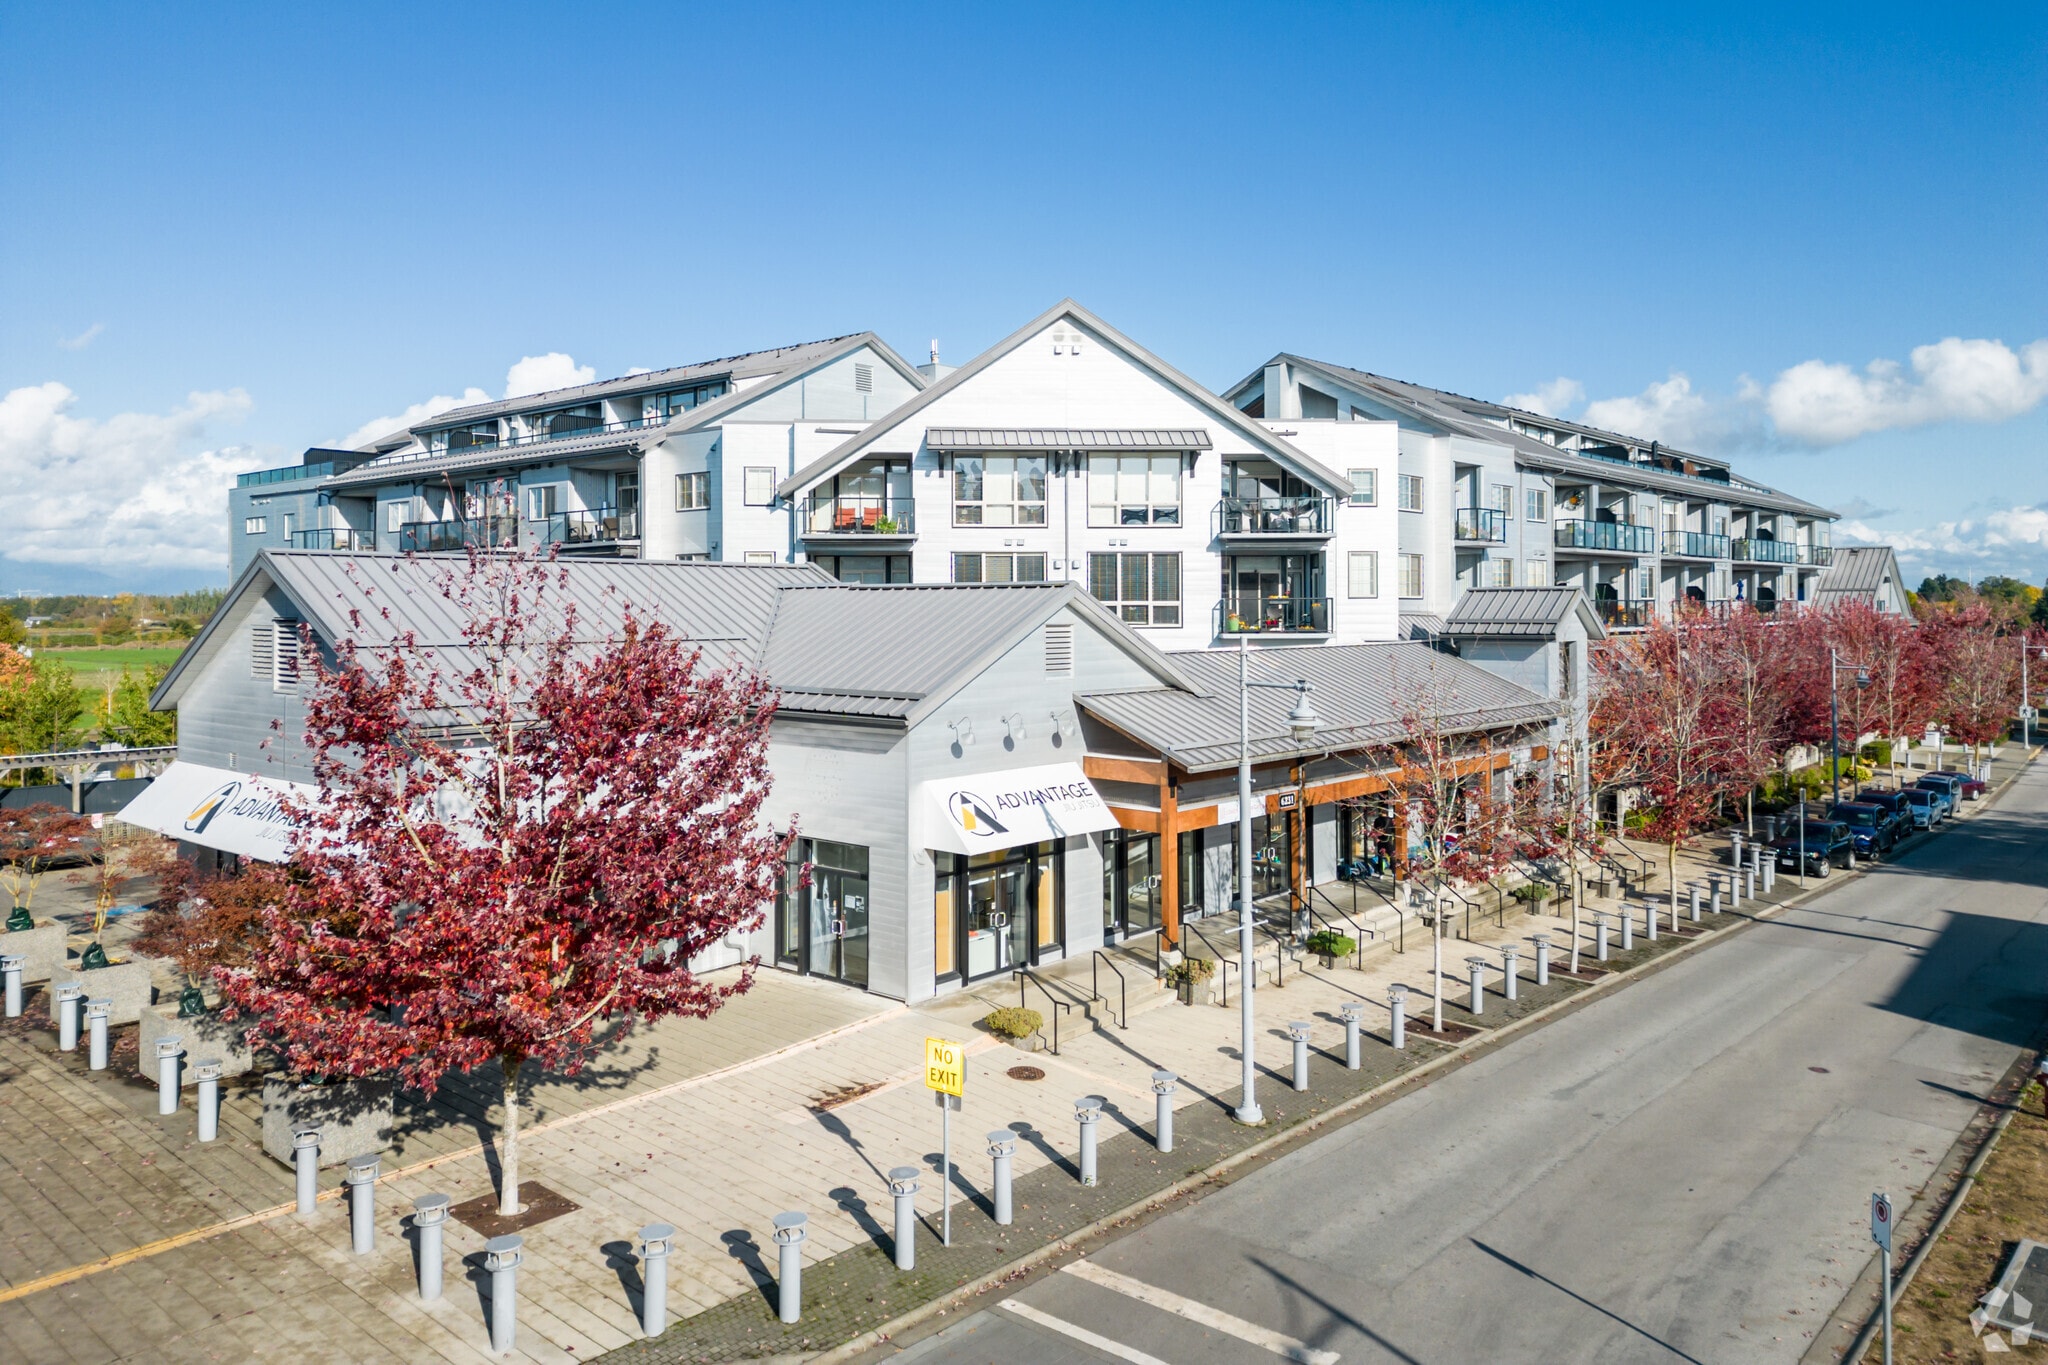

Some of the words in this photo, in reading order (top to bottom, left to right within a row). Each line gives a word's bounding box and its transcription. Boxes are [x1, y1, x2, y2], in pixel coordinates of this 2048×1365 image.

[996, 782, 1093, 810] ADVANTAGE
[934, 1047, 953, 1065] NO
[930, 1067, 957, 1087] EXIT
